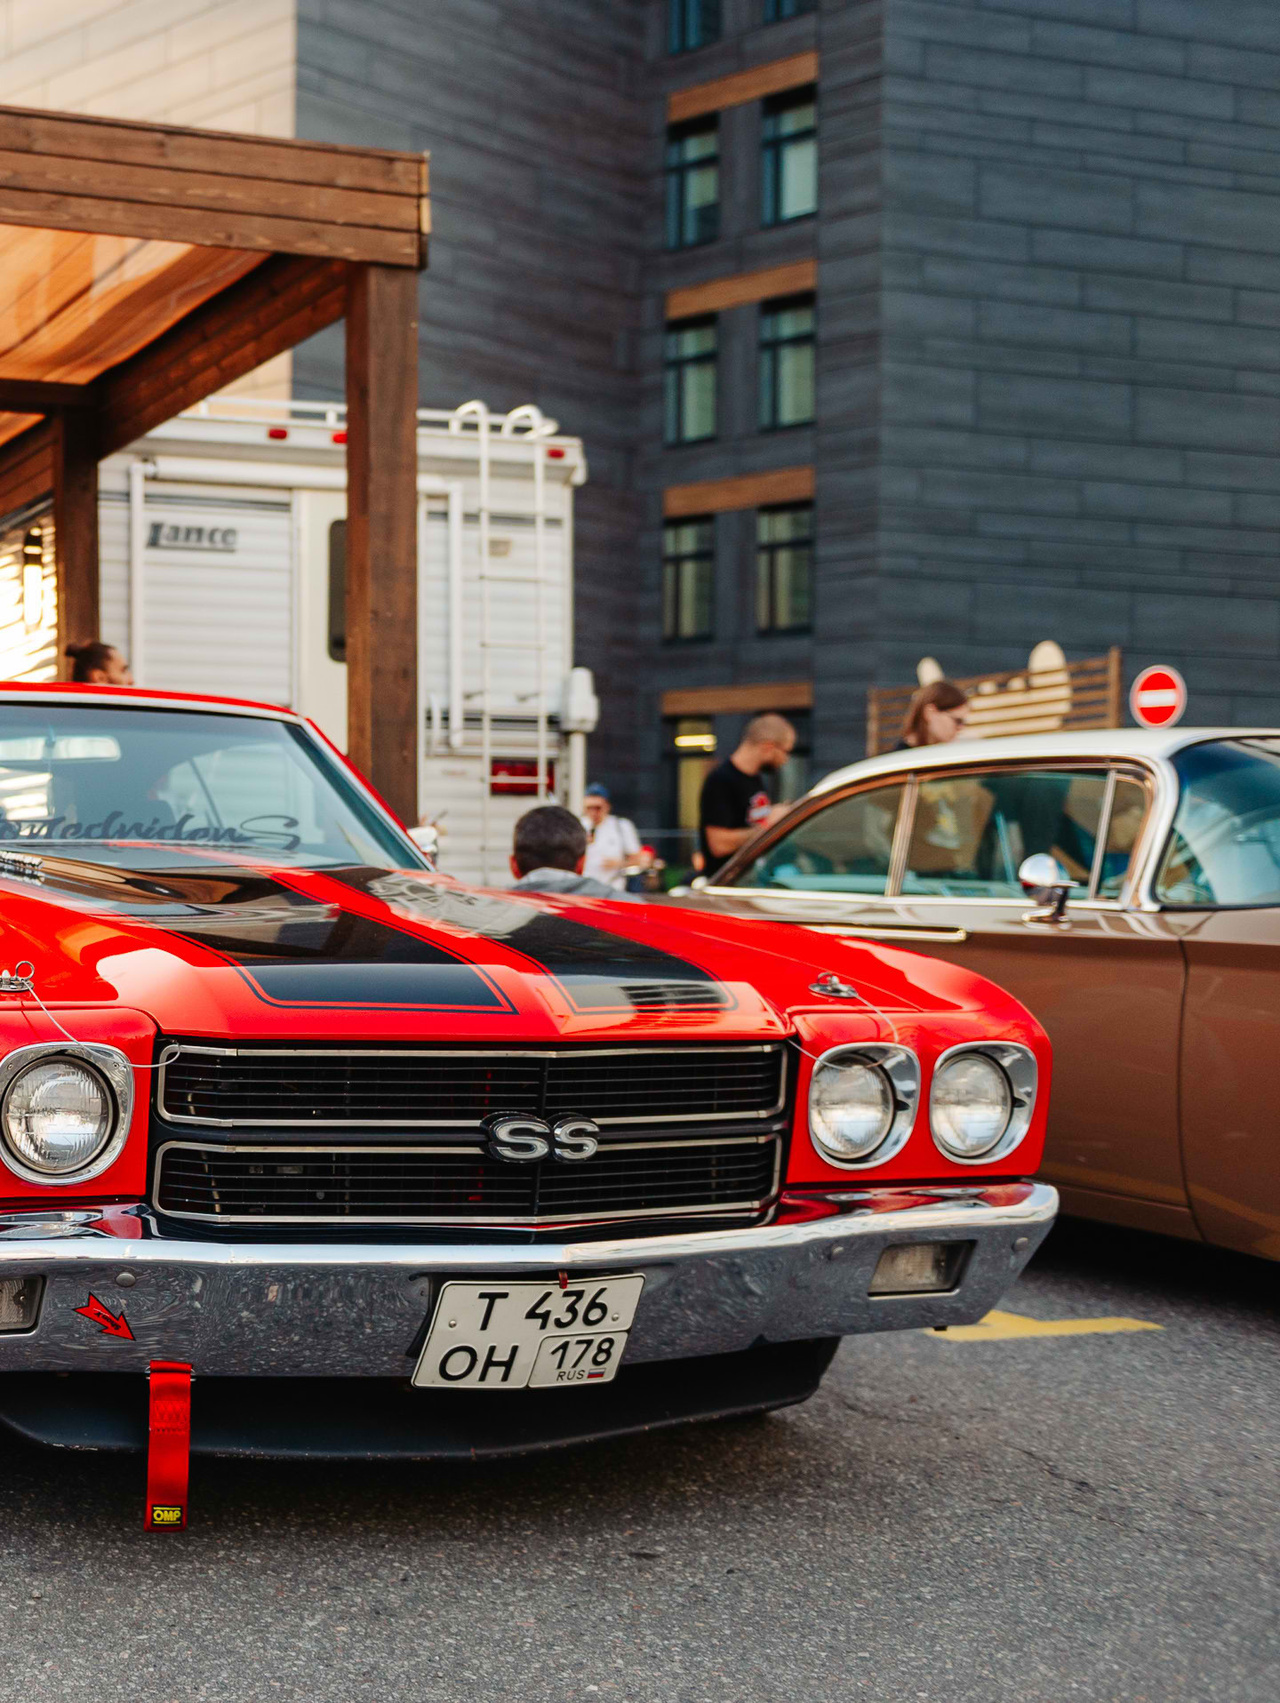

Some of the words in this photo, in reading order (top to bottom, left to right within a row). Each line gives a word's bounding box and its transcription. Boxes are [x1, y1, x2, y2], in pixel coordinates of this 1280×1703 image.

[146, 523, 237, 551] Lance
[491, 1116, 600, 1161] SS
[478, 1292, 509, 1331] T
[524, 1287, 608, 1330] 436
[550, 1337, 615, 1370] 178
[556, 1369, 585, 1381] RUS
[153, 1508, 181, 1522] OMP
